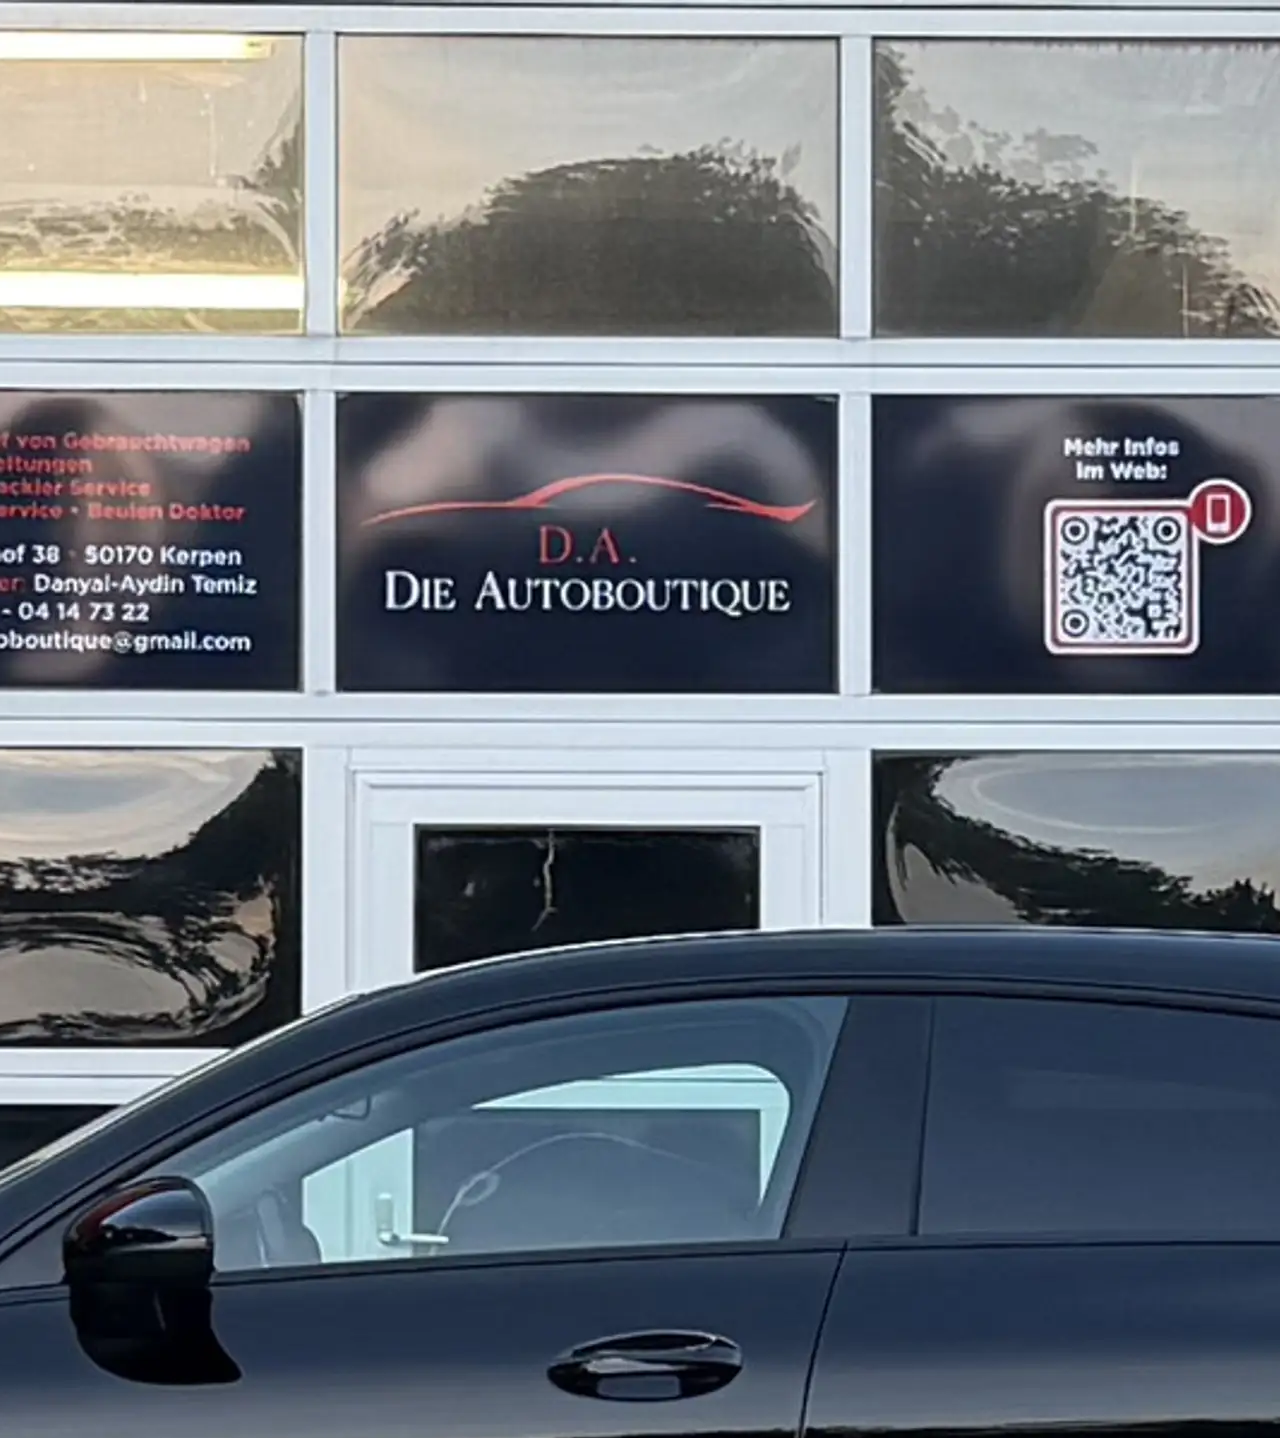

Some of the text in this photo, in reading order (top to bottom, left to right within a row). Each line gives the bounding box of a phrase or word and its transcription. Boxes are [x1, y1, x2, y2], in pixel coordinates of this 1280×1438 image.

[15, 433, 56, 449] von
[64, 432, 251, 454] Gebrauchtwagen
[1064, 436, 1179, 457] Mehr Infos
[1110, 460, 1167, 480] Web:
[71, 479, 151, 497] Service
[88, 502, 163, 520] Beulen
[170, 503, 246, 520] Doktor
[32, 544, 60, 564] 38
[84, 544, 154, 566] 50170
[160, 545, 242, 568] Kerpen
[34, 573, 185, 596] Danyal-Aydin
[191, 574, 258, 594] Temiz
[18, 602, 50, 620] 04
[56, 602, 80, 621] 14
[88, 602, 115, 621] 73
[121, 603, 150, 622] 22
